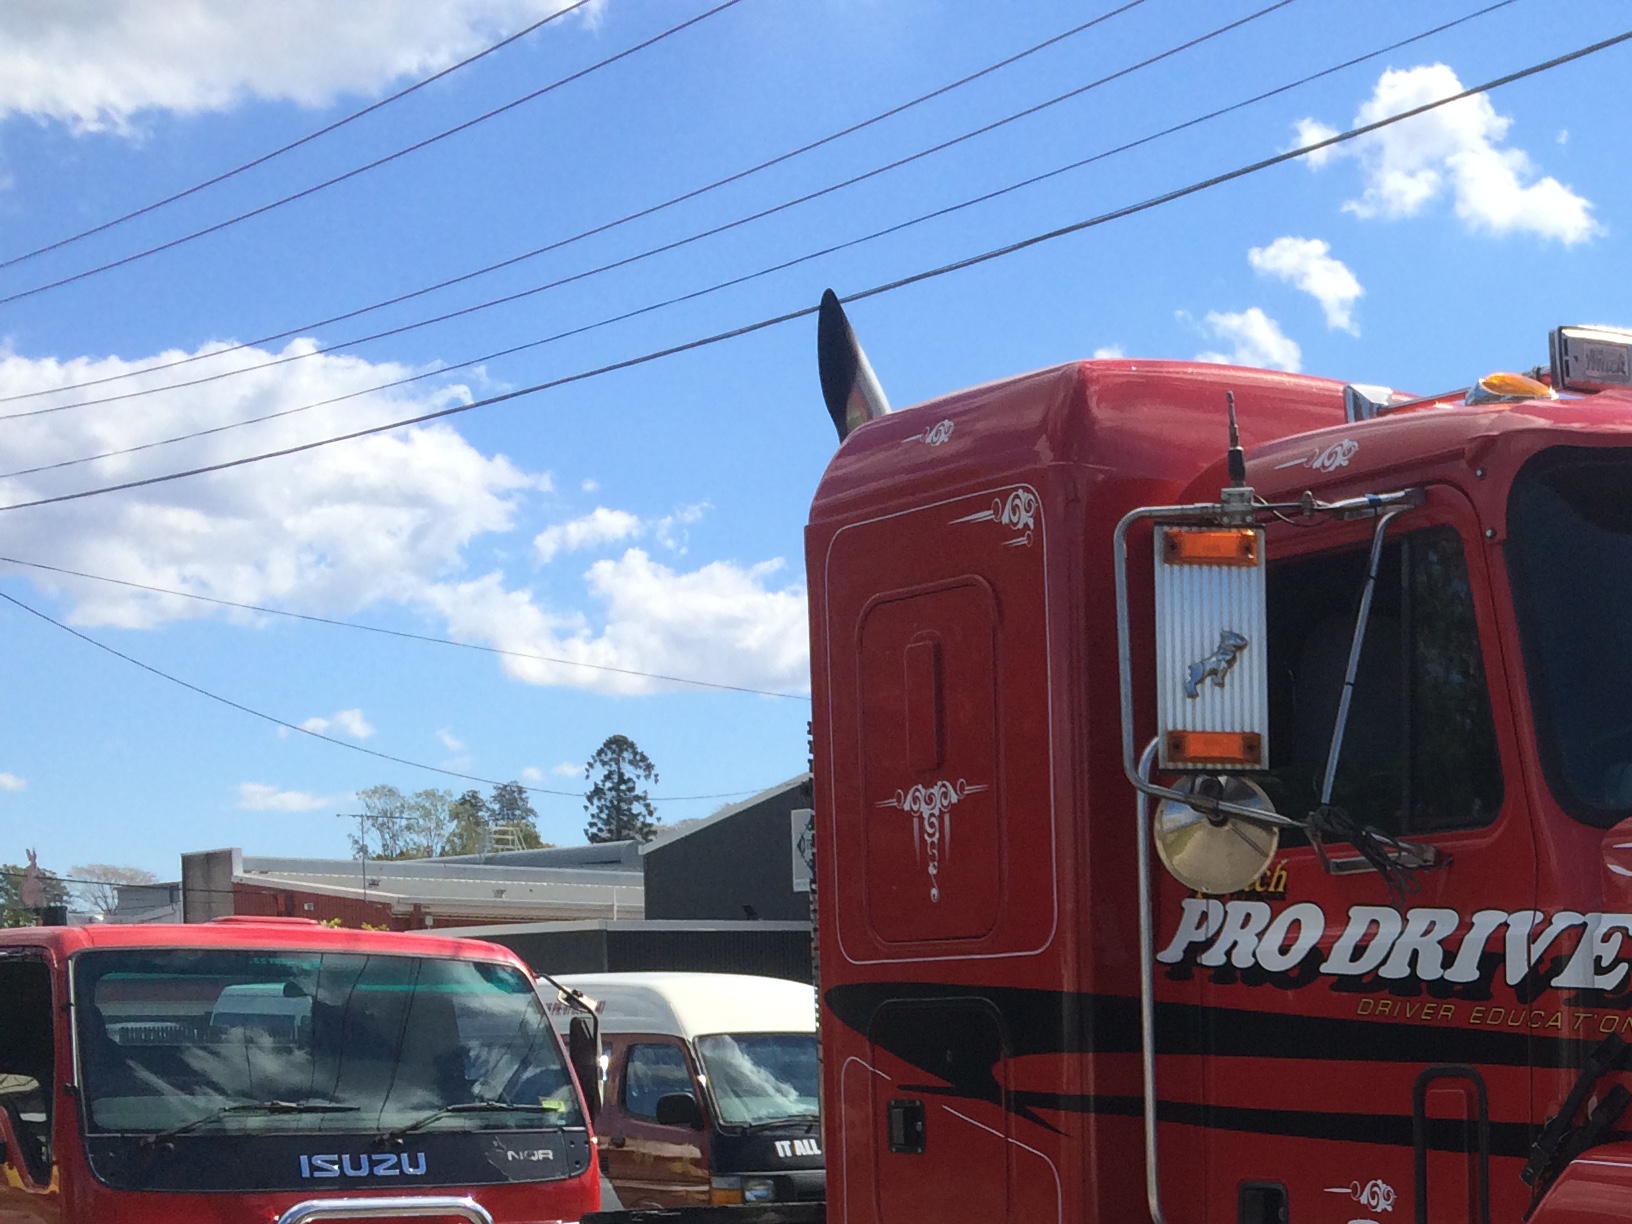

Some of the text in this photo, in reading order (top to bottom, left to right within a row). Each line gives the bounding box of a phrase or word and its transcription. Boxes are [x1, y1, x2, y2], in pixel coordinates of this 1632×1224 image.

[1156, 899, 1326, 972] PRO
[1356, 997, 1455, 1020] DRIVER
[774, 1139, 821, 1157] IT ALL
[299, 1152, 427, 1178] ISUZU
